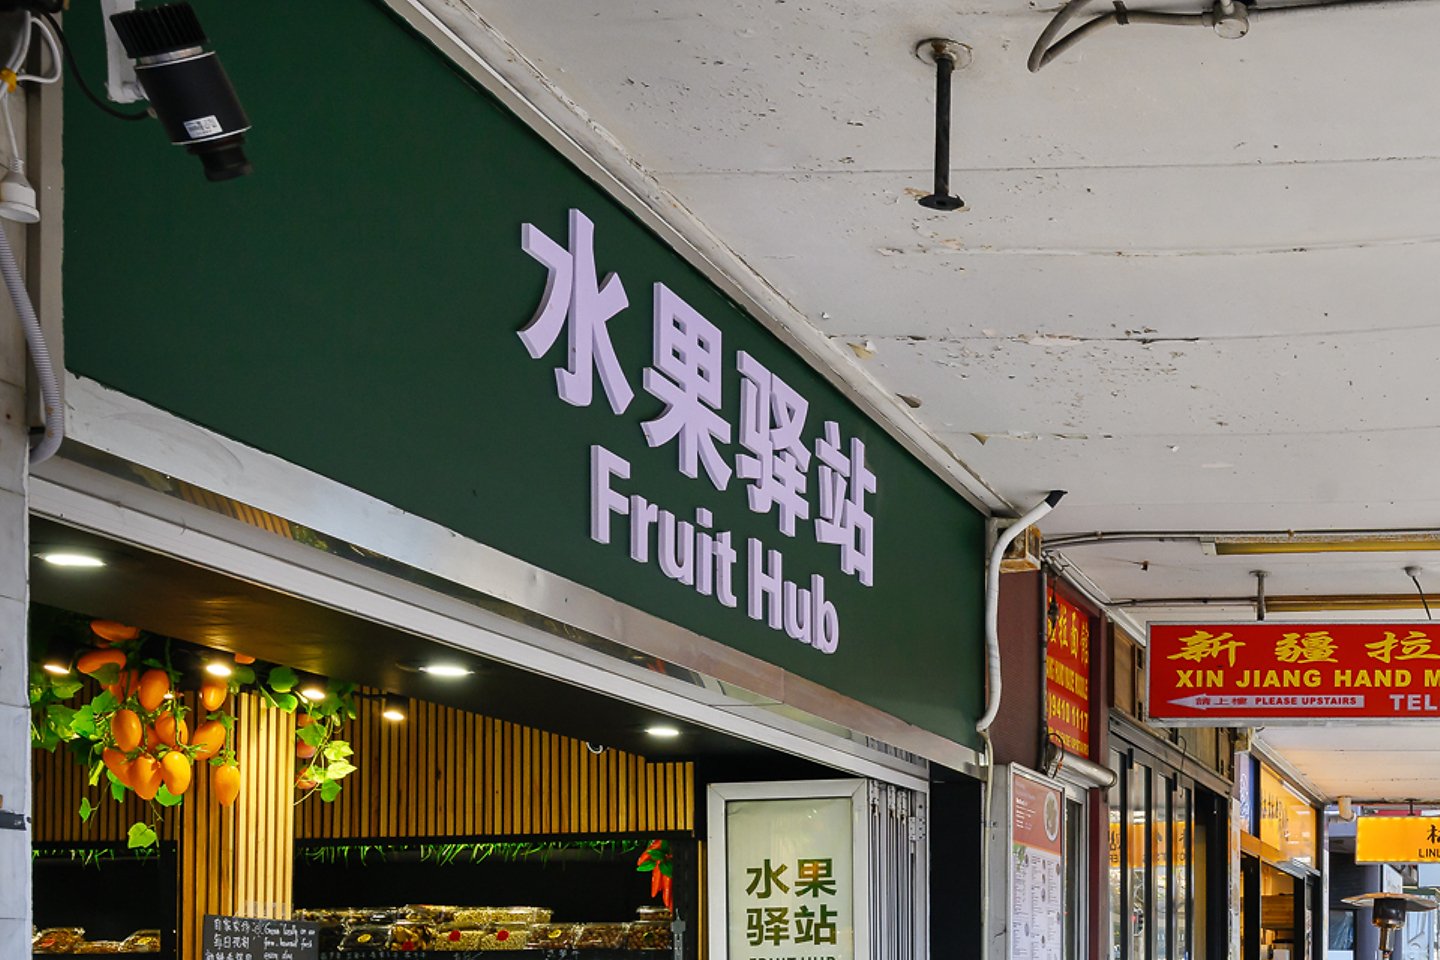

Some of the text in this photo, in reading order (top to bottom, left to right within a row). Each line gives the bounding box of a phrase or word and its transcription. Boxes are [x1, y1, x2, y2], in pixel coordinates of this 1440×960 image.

[516, 207, 877, 587] 水果驿站
[590, 444, 839, 655] Fruit Hub
[1175, 669, 1224, 688] XIN
[1236, 669, 1322, 688] JIANG
[1334, 669, 1412, 688] HAND
[1254, 696, 1298, 706] PLEASE
[1301, 696, 1357, 706] UPSTAIRS
[746, 858, 837, 899] 水果
[746, 903, 838, 947] 驿站
